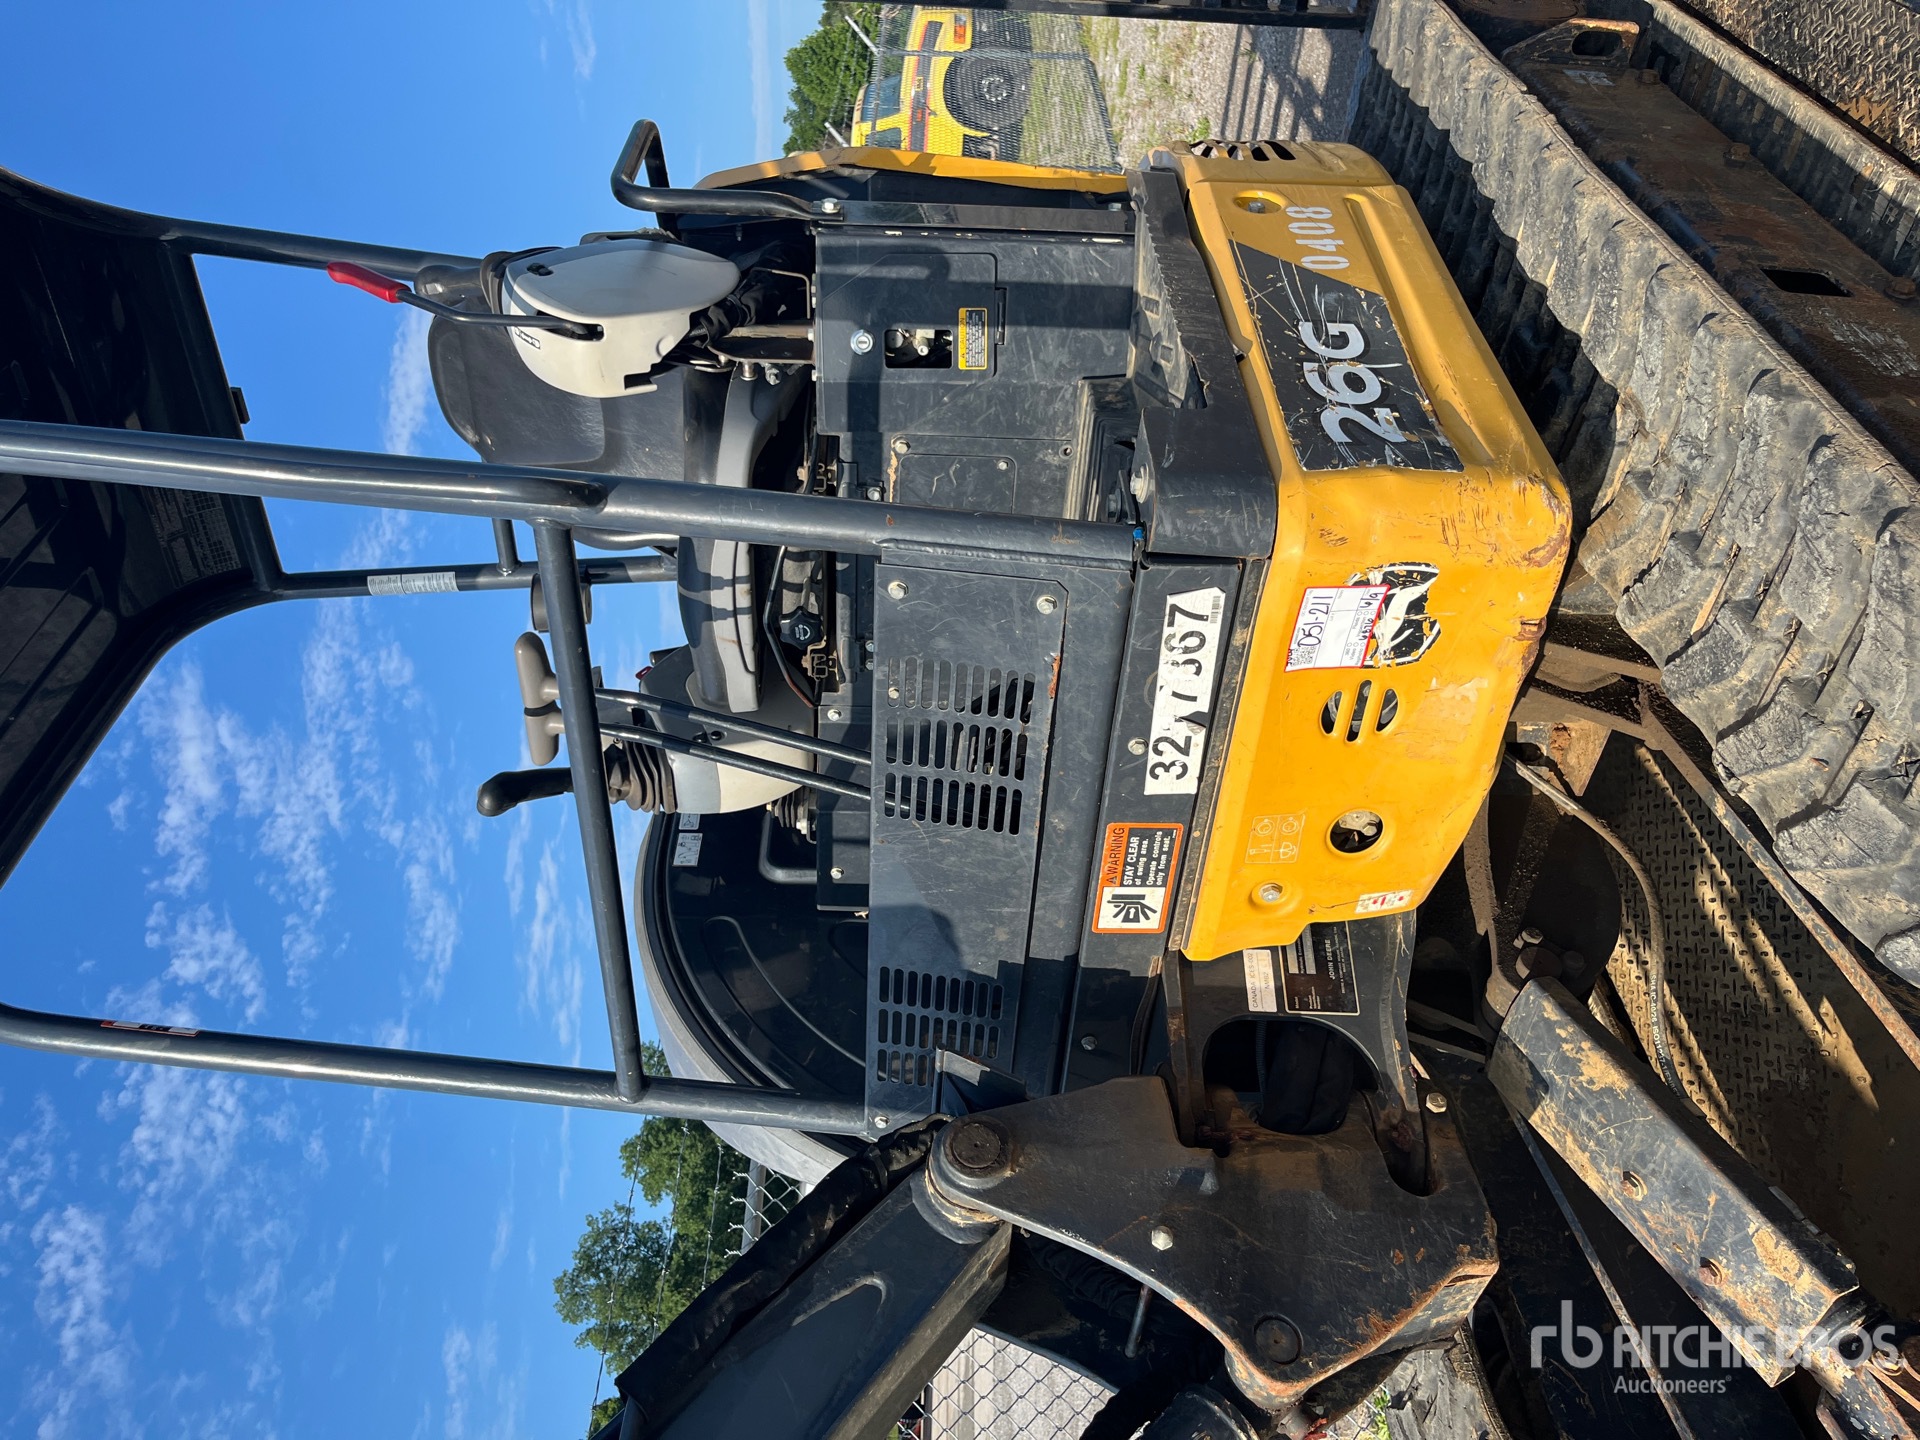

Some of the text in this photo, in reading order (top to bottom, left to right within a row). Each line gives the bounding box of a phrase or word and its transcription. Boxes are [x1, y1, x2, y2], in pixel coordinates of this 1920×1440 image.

[1286, 206, 1349, 270] 0408
[1298, 322, 1407, 442] 26G
[1297, 596, 1333, 647] 051-211
[1106, 828, 1124, 875] WARNING
[1123, 837, 1140, 885] STAY CLEAR
[1136, 858, 1147, 876] swing
[1146, 831, 1162, 885] Operate controls
[1156, 836, 1170, 885] only from seat.
[1250, 982, 1258, 1008] CANADA
